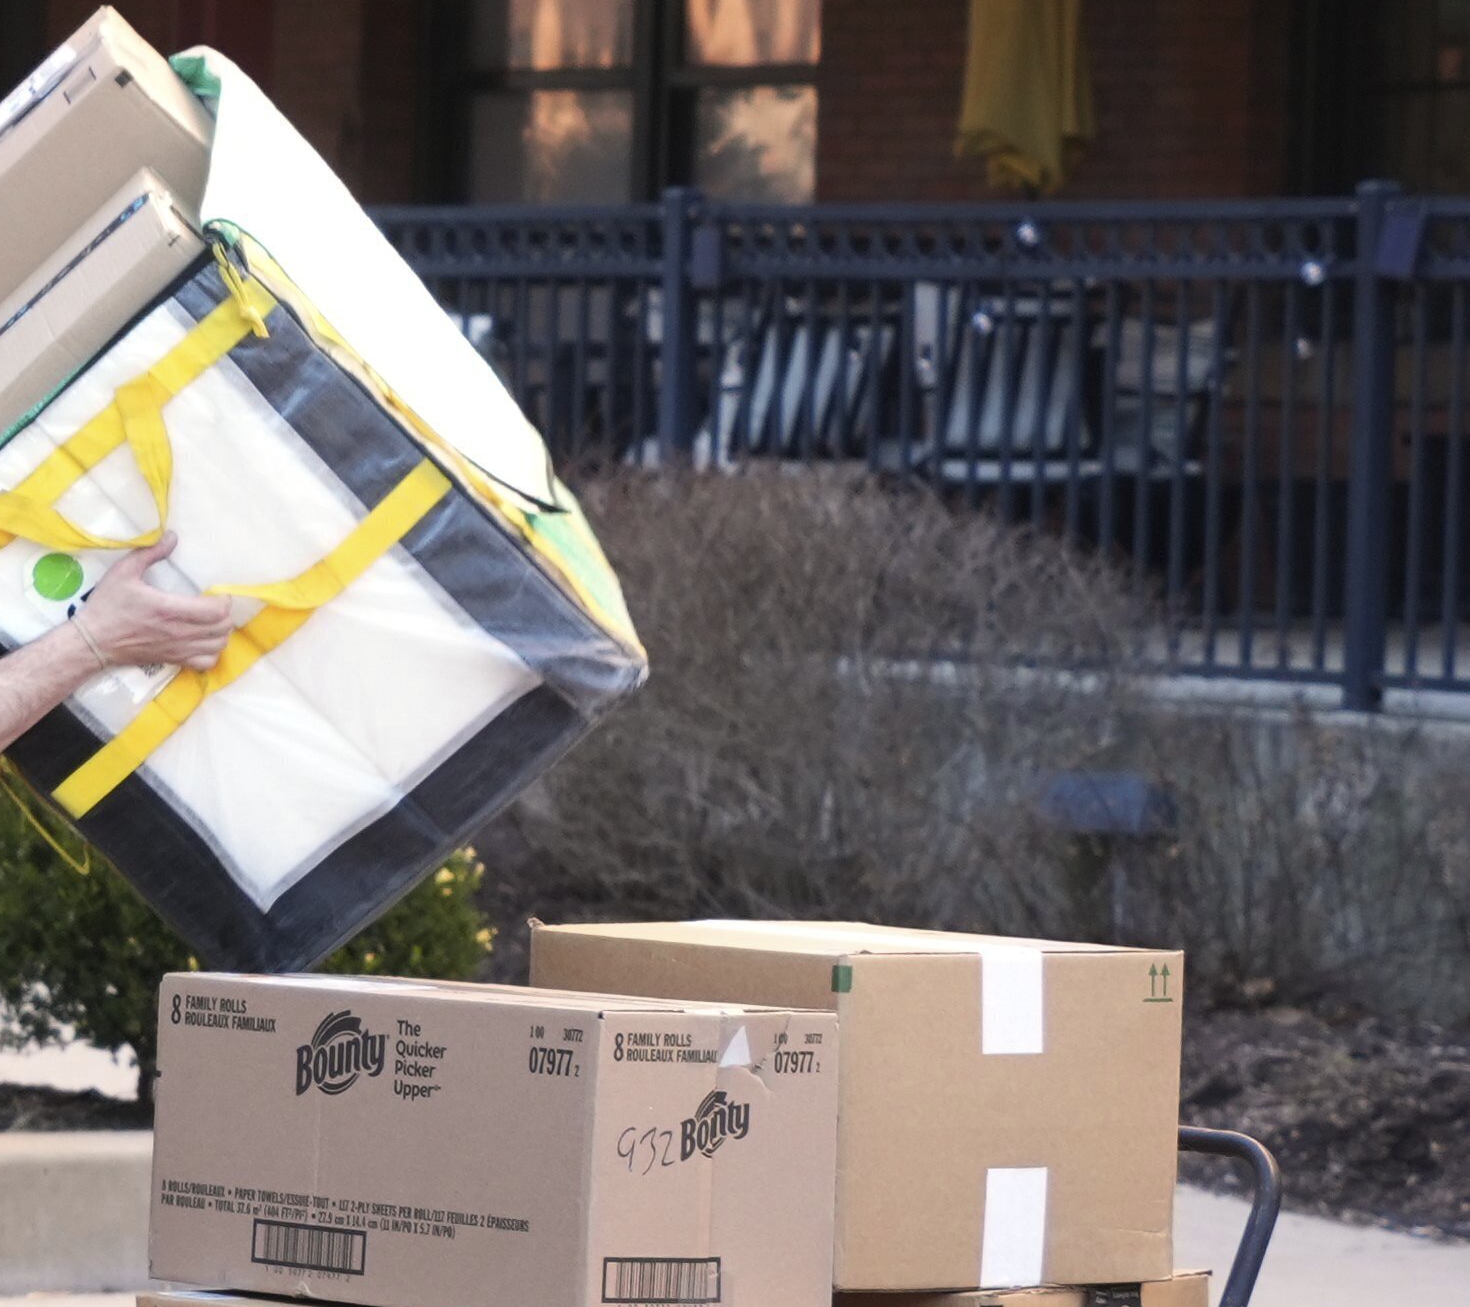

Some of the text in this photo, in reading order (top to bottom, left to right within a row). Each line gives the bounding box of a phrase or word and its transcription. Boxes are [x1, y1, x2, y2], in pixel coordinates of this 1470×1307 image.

[171, 993, 181, 1025] 8
[185, 994, 247, 1014] FAMILY ROLLS
[184, 1011, 277, 1033] ROULEAUX FAMILIAUX
[397, 1019, 421, 1037] The
[395, 1040, 447, 1059] Quicker
[614, 1032, 624, 1062] 8
[627, 1033, 692, 1047] FAMILY ROLLS
[295, 1027, 386, 1096] Bounty
[528, 1046, 580, 1077] 07977 2
[626, 1048, 718, 1064] ROULEAUX FAMILIAU
[774, 1051, 821, 1074] 07977 2
[394, 1060, 436, 1078] Picker
[394, 1080, 433, 1101] Upper
[680, 1101, 750, 1162] Bonty
[160, 1193, 174, 1205] PAR
[215, 1199, 235, 1213] TOTAL
[234, 1187, 256, 1201] PAPER
[351, 1200, 370, 1214] 2-PLY
[372, 1203, 398, 1217] SHEETS
[398, 1206, 412, 1219] PER
[446, 1210, 479, 1227] FEUILLES
[479, 1215, 485, 1228] 2
